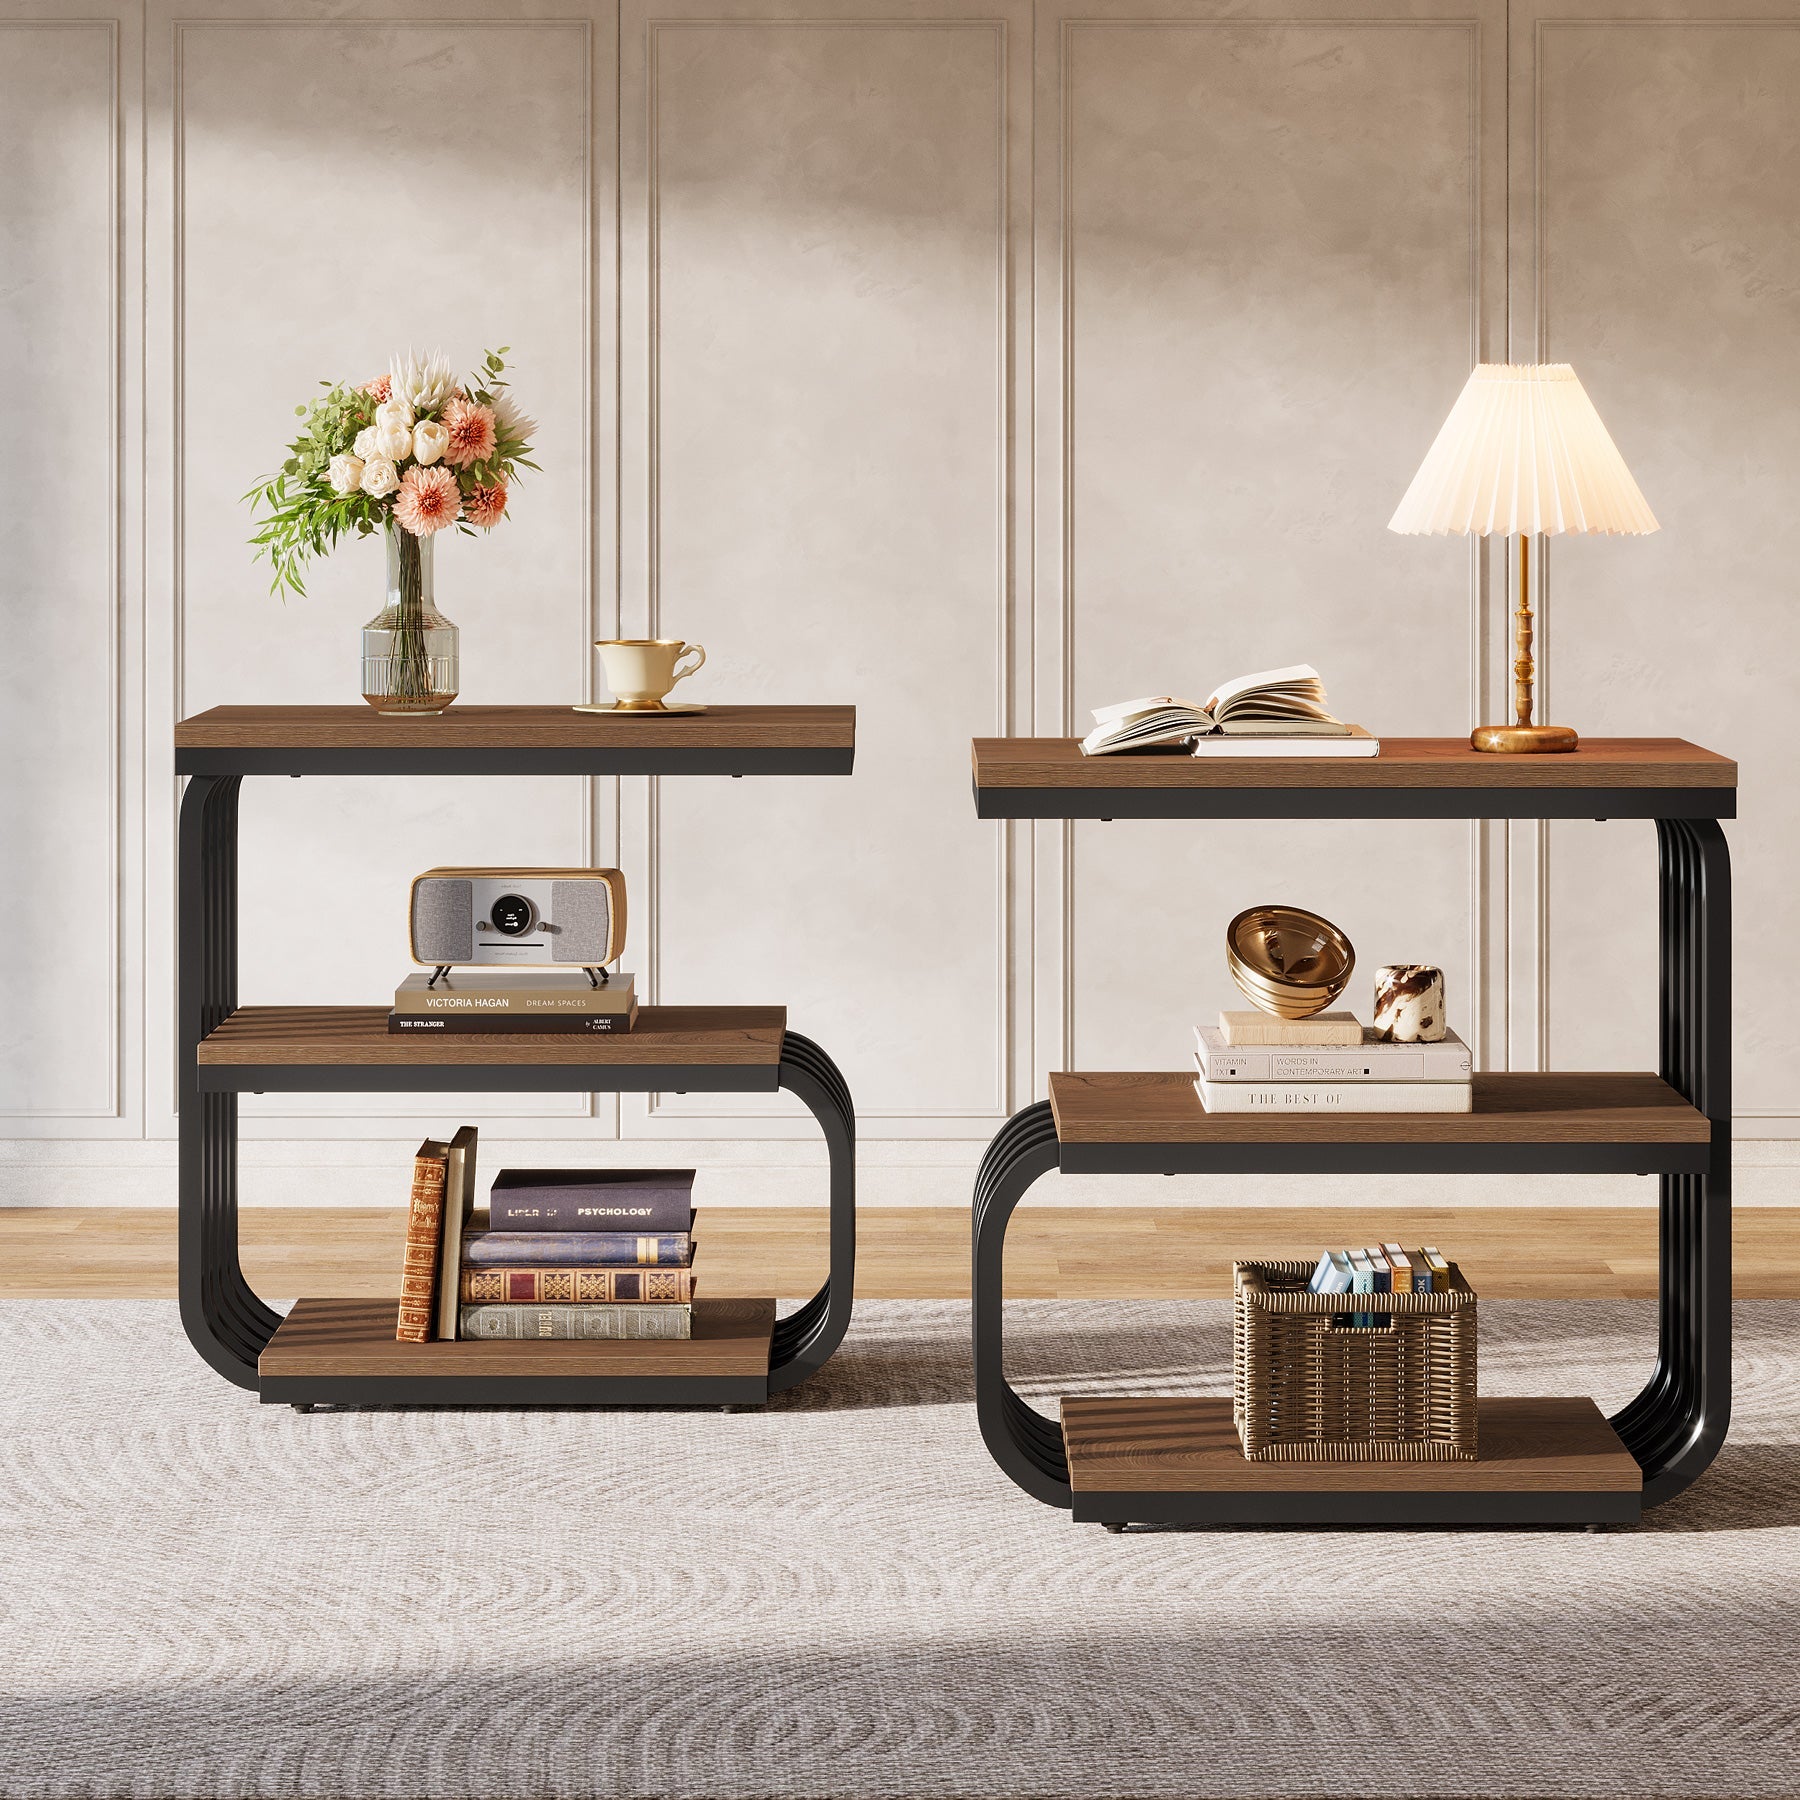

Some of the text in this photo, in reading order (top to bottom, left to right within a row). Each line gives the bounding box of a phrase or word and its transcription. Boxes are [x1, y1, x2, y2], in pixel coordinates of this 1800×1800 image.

[426, 998, 509, 1007] VICTORIA HAGAN
[526, 999, 586, 1007] DREAM SPACES
[399, 1020, 445, 1028] THE STRANGER
[1214, 1058, 1247, 1066] VITAMIN
[1276, 1058, 1308, 1066] WORDS
[1276, 1068, 1363, 1076] CONTEMPORARY ART
[1248, 1093, 1344, 1104] THE BEST OF
[577, 1207, 653, 1216] PSYCHOLOGY
